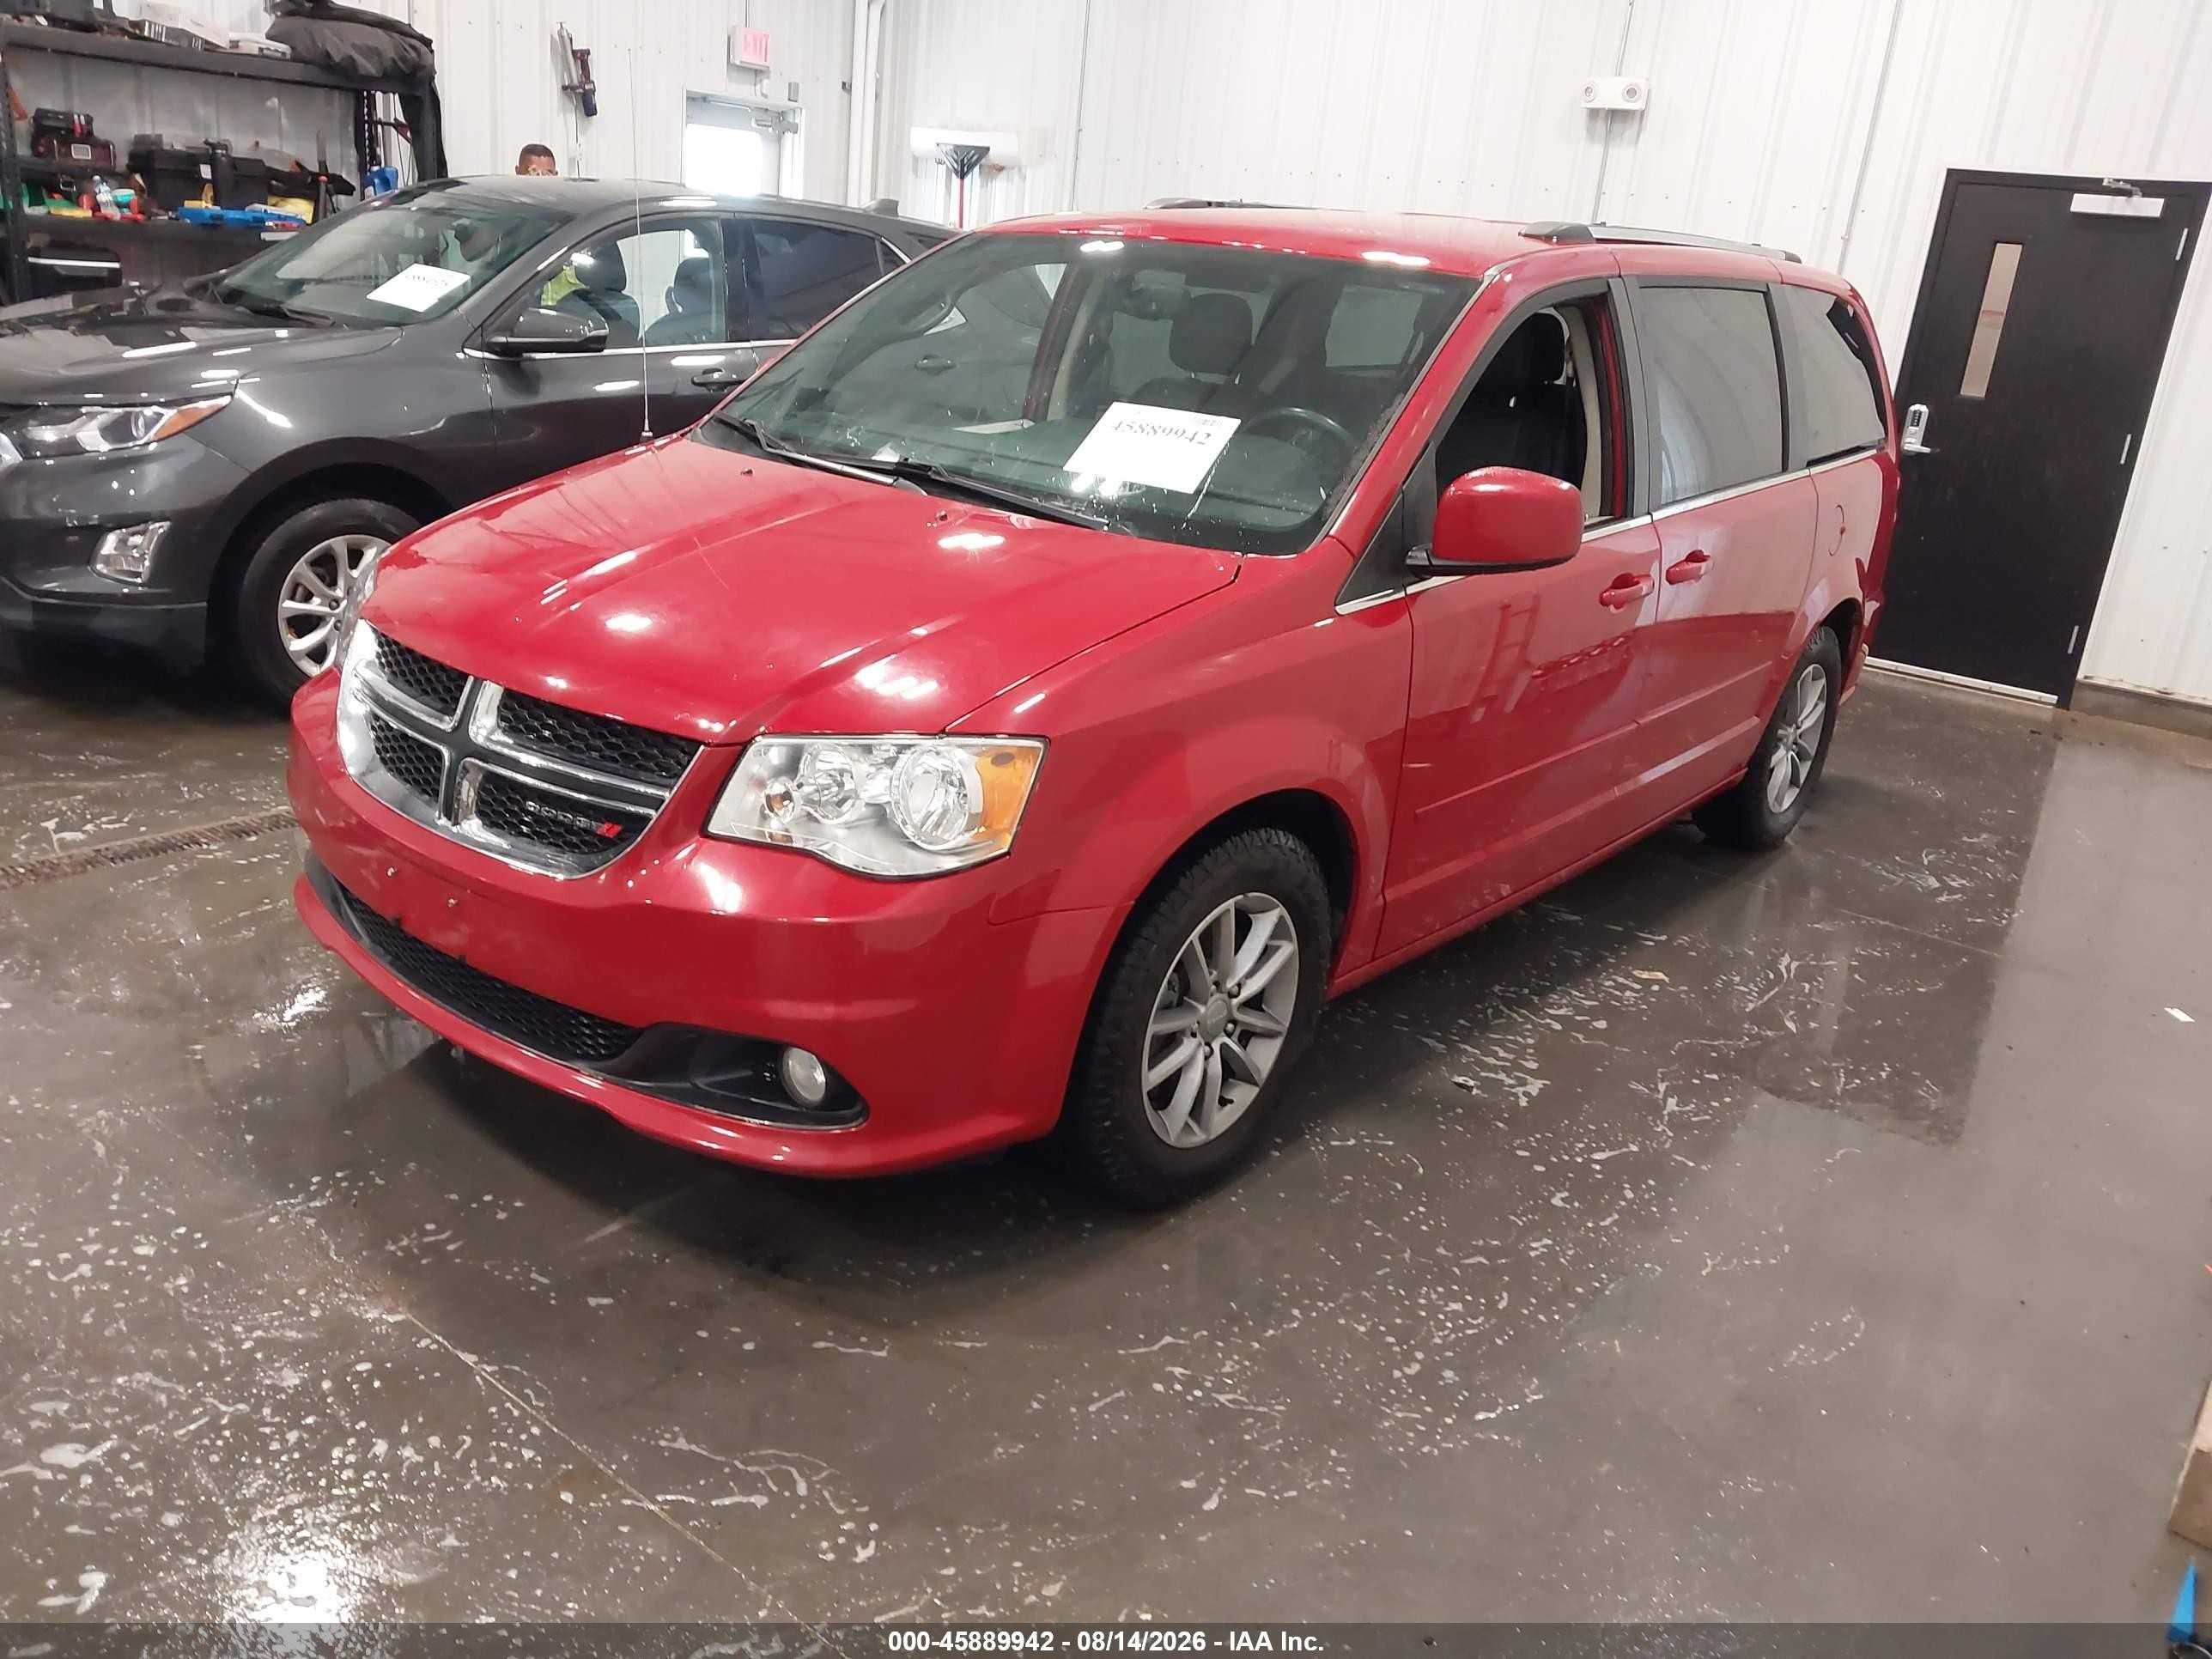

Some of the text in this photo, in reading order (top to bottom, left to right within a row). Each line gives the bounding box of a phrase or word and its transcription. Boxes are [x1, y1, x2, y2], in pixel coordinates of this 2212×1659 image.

[742, 31, 769, 62] EXIT
[1111, 421, 1212, 445] 45889942
[525, 800, 605, 835] DODGE
